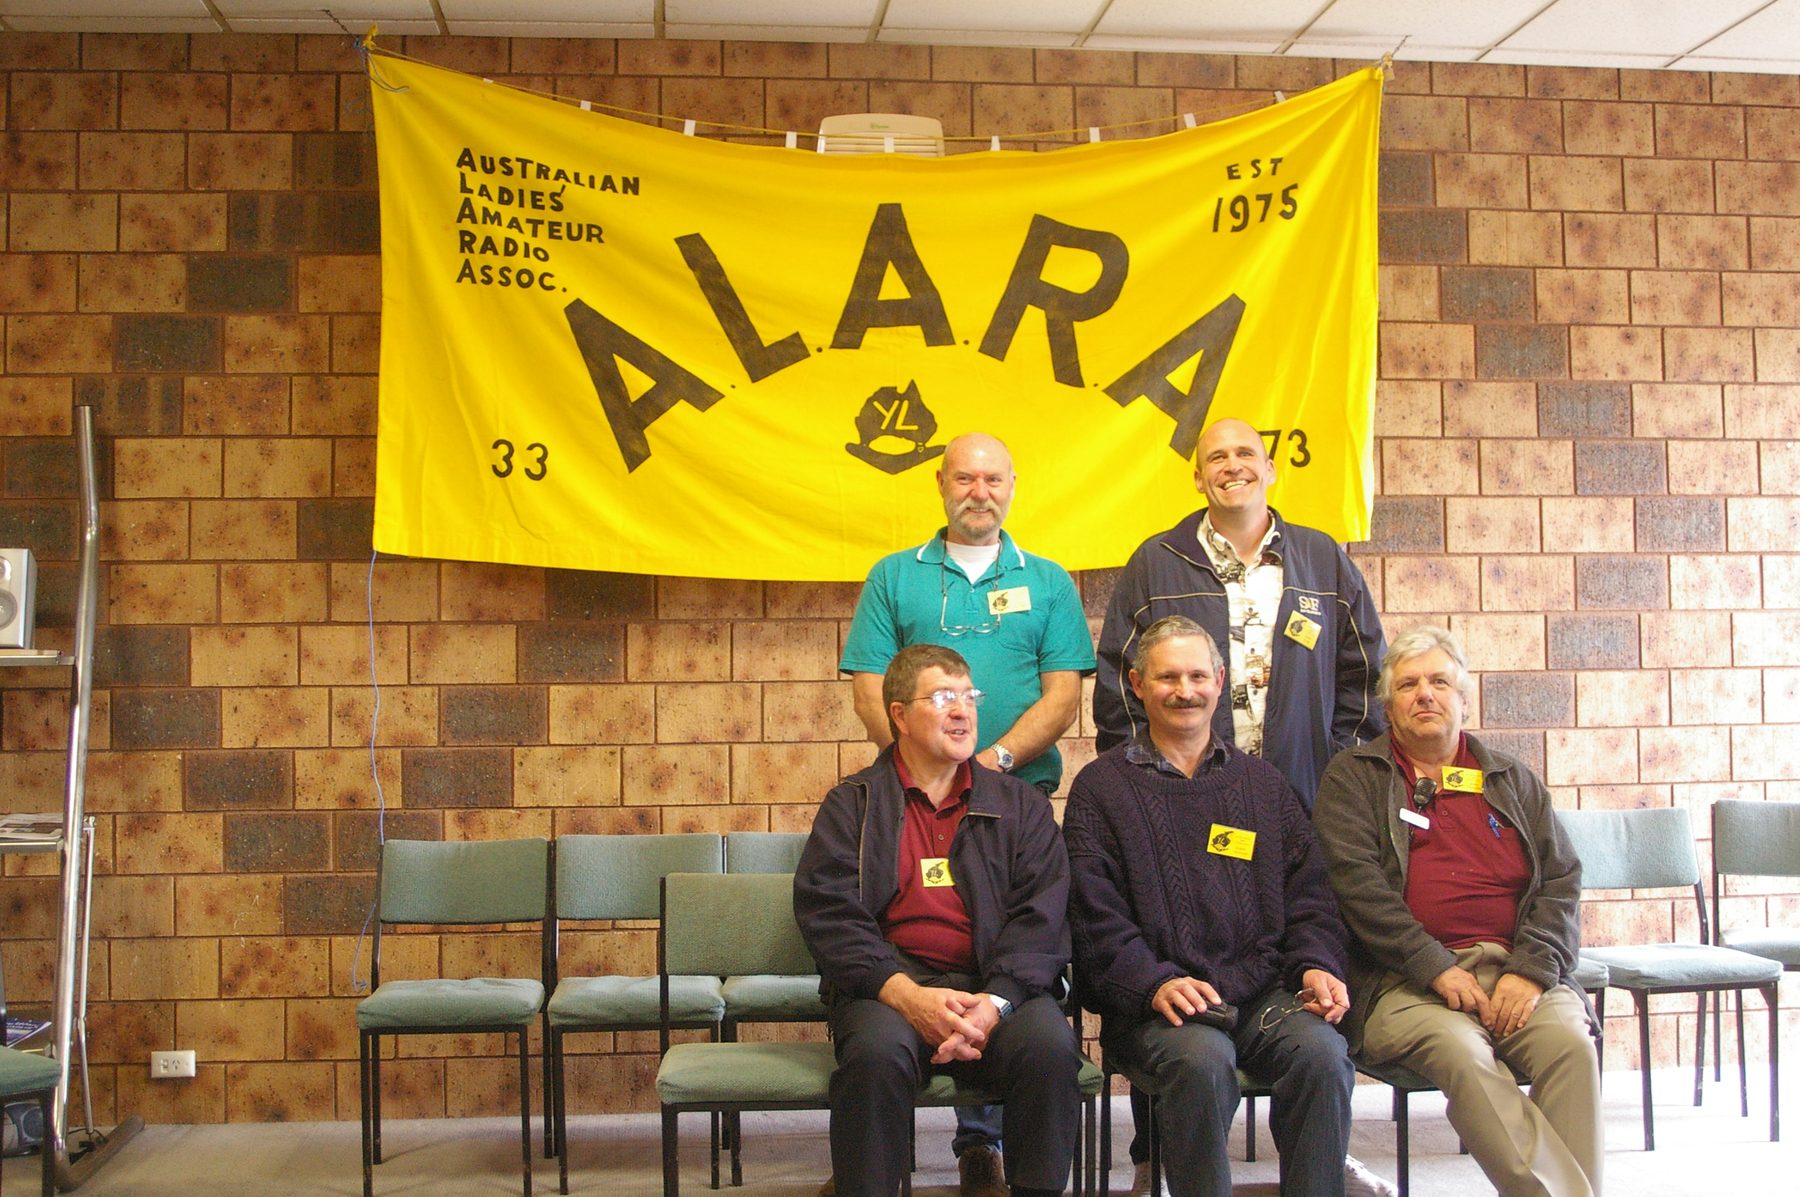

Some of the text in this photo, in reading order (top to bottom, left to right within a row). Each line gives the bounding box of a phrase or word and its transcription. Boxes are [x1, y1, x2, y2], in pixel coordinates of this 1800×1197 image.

[456, 147, 640, 196] AUSTRALIAN
[1226, 157, 1284, 180] EST
[456, 197, 605, 244] AMATEUR
[1212, 183, 1298, 233] 1975
[459, 230, 550, 262] RADIO
[456, 258, 567, 293] ASSOC.
[873, 400, 919, 430] YL
[492, 439, 549, 480] 33
[1258, 428, 1311, 468] 73
